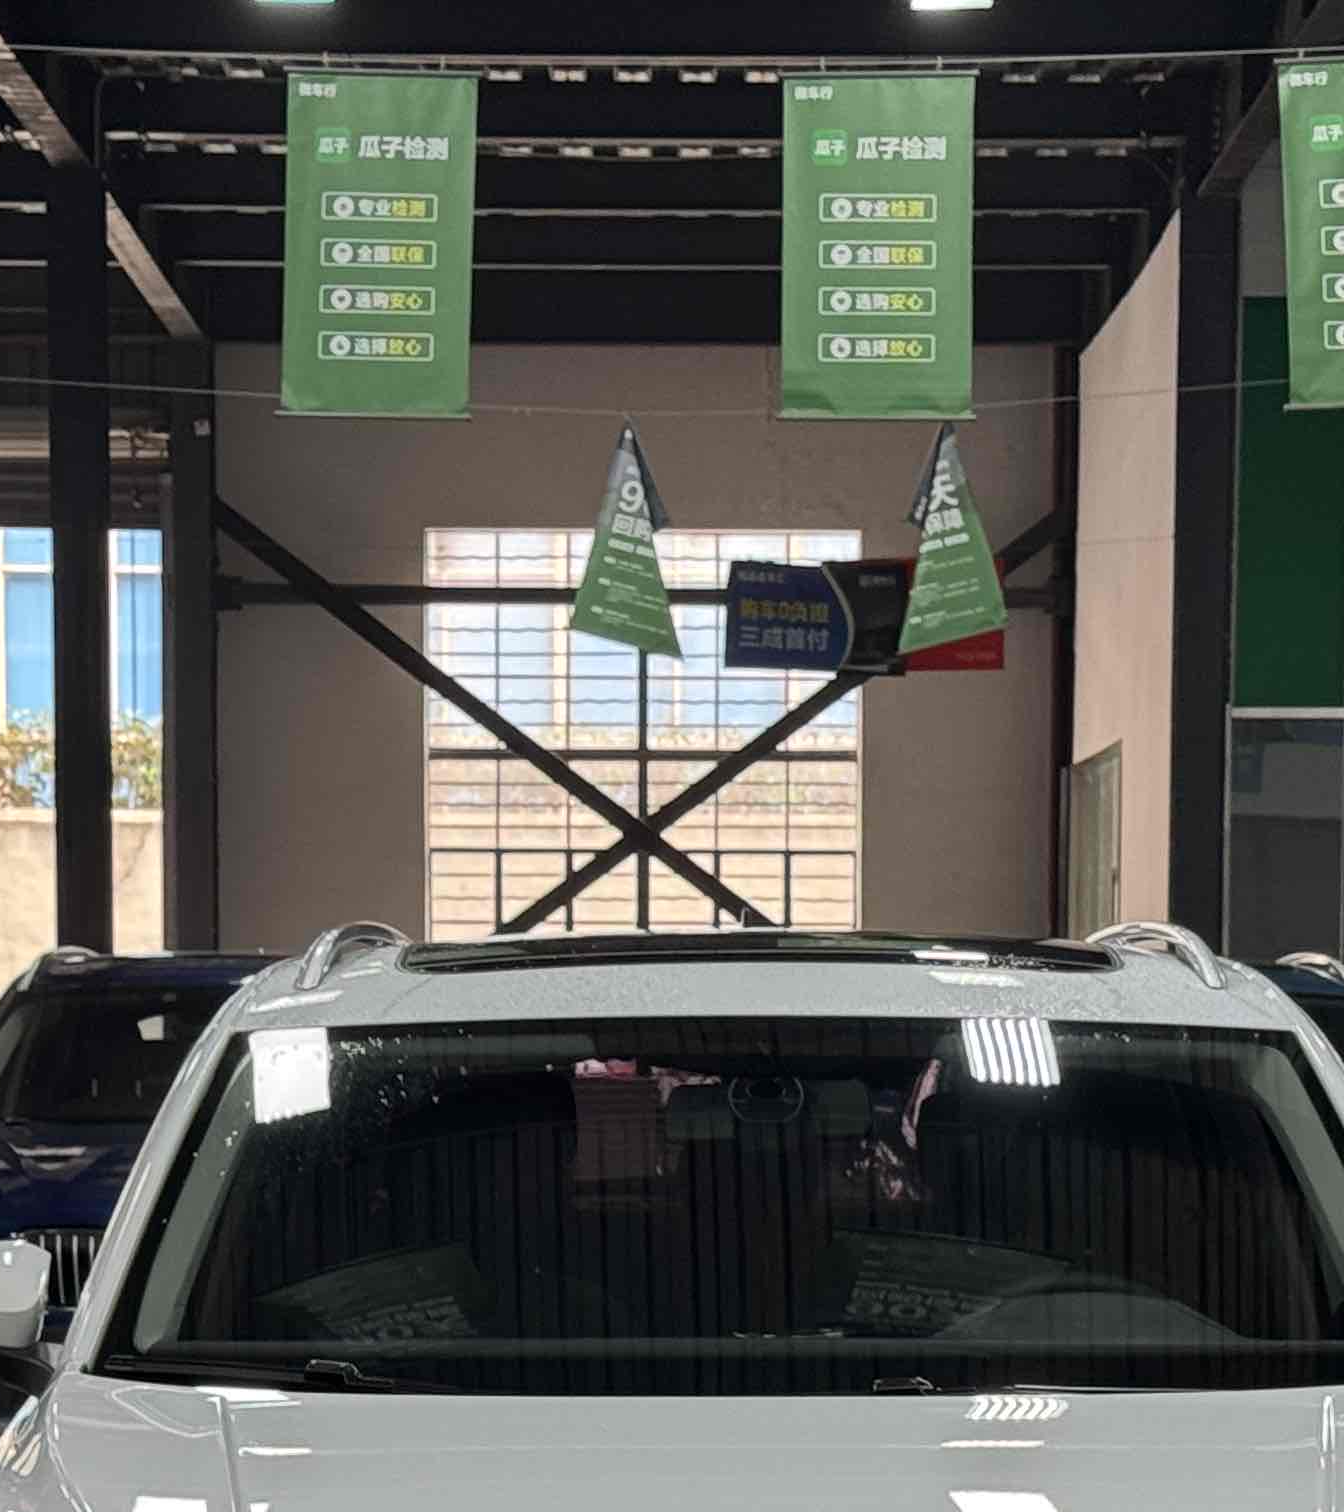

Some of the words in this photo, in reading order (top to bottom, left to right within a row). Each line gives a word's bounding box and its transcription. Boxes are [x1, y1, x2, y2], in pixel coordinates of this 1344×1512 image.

[358, 136, 449, 160] 瓜子检测
[856, 136, 947, 161] 瓜子检测
[357, 197, 426, 217] 专业检测
[856, 198, 925, 218] 专业检测
[738, 625, 830, 651] 三成首付
